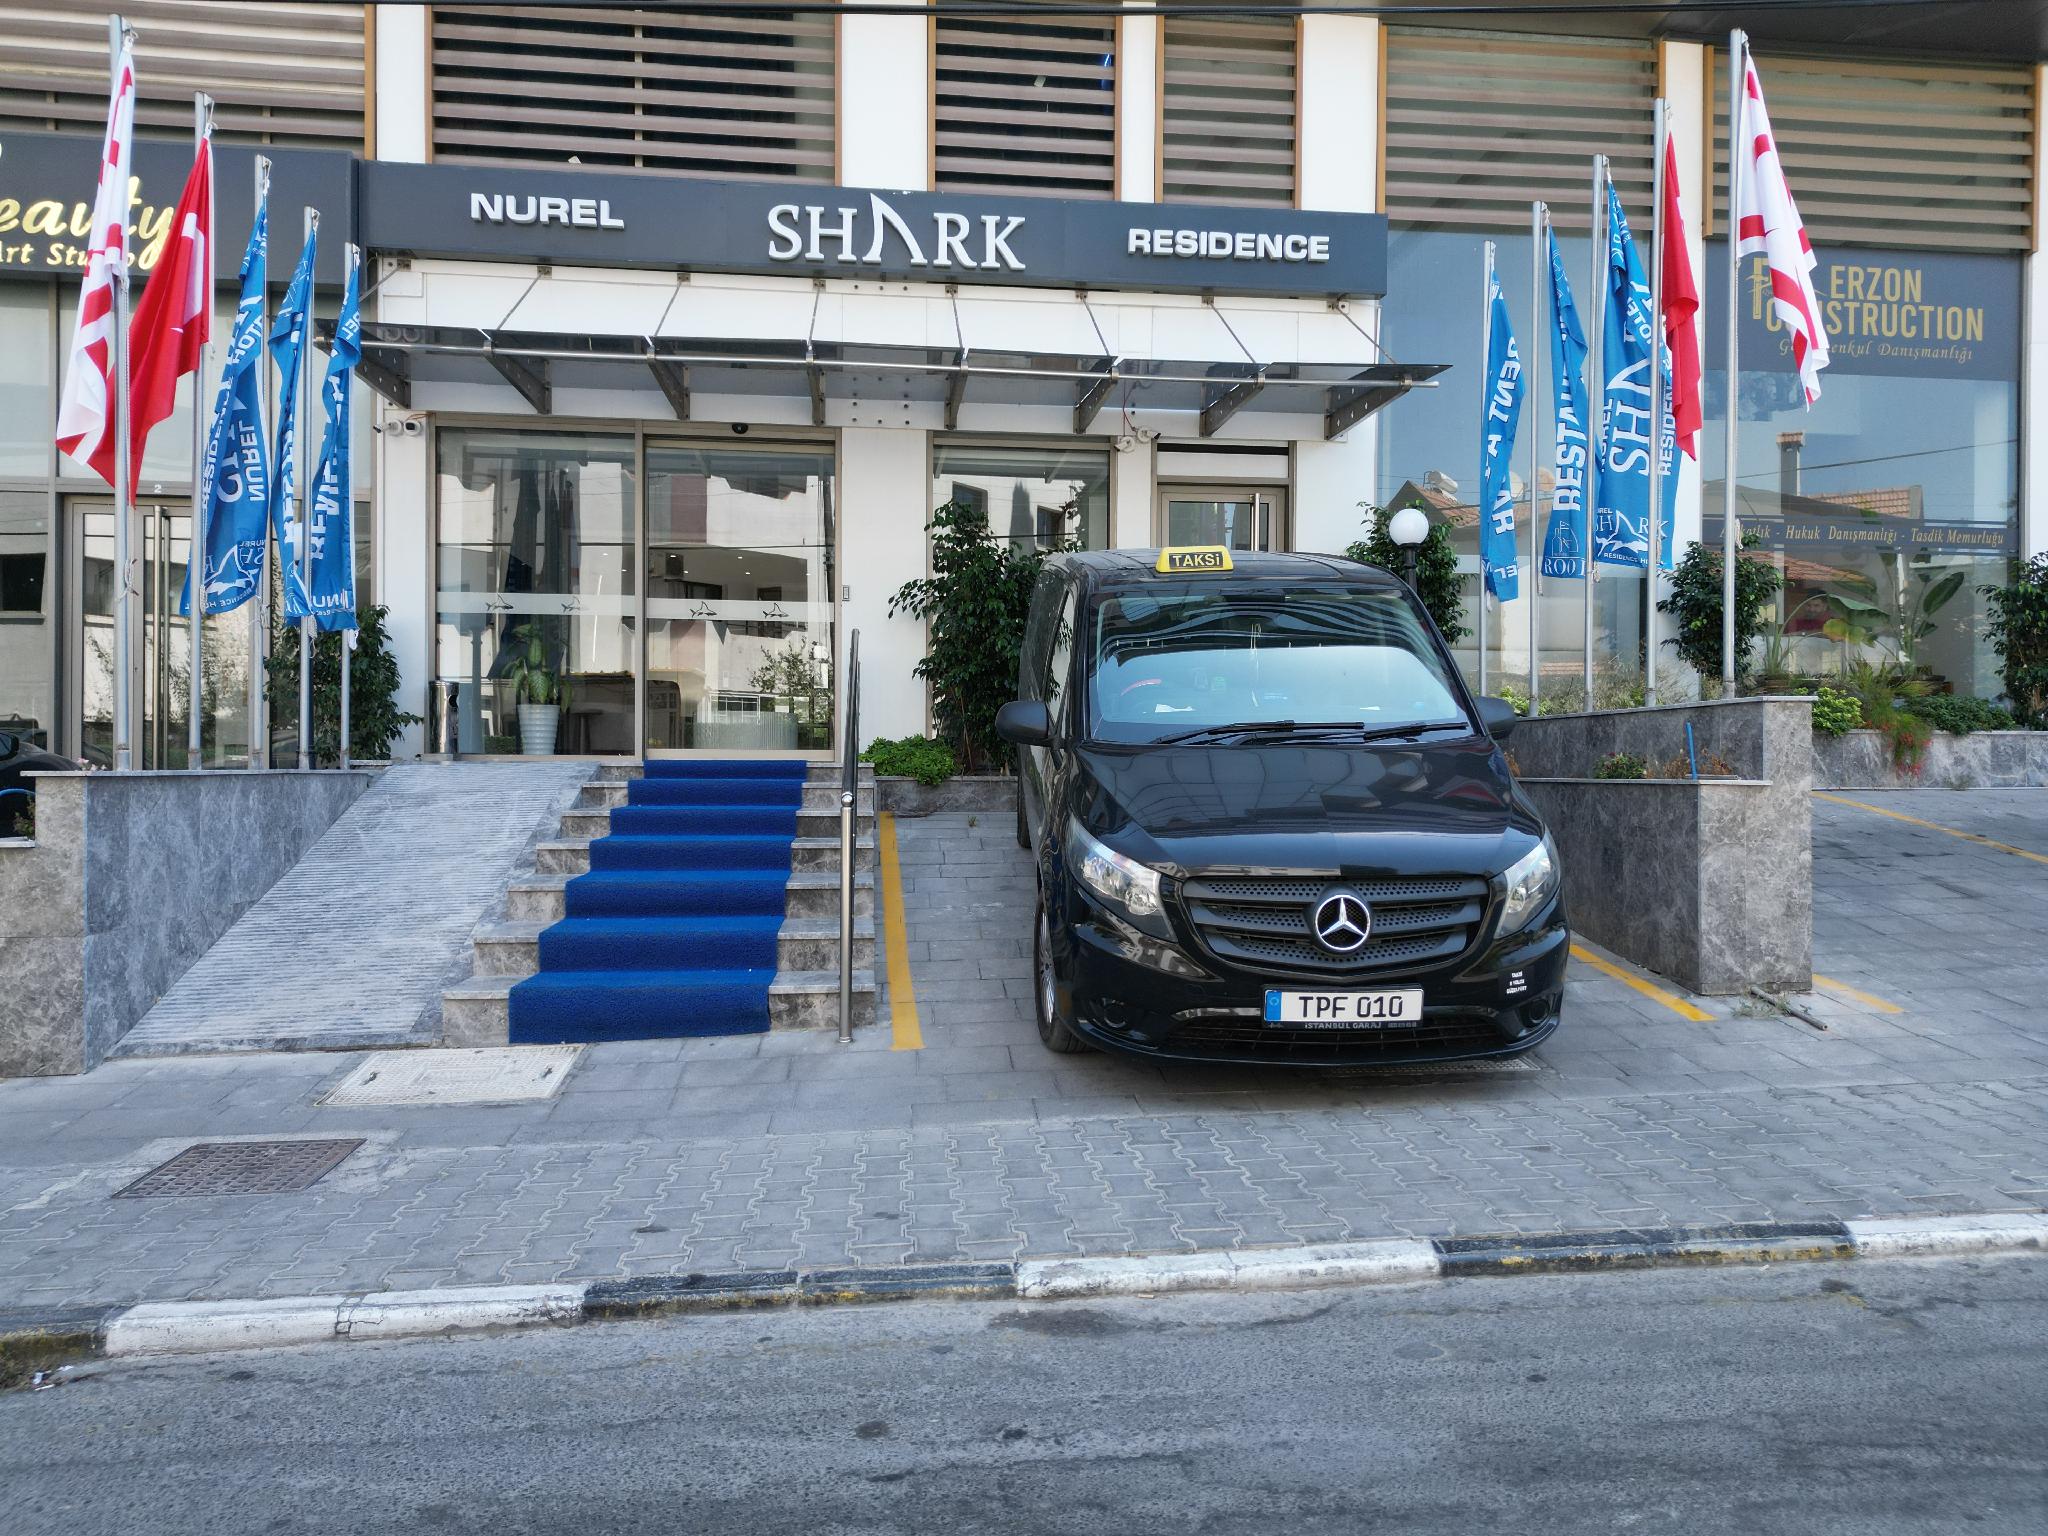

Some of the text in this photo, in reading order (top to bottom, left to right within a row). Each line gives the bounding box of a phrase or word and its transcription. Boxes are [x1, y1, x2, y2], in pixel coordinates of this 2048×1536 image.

[0, 176, 174, 270] eauty
[470, 192, 625, 230] NUREL
[767, 192, 1027, 271] SHARK
[1127, 228, 1330, 263] RESIDENCE
[46, 243, 135, 266] Stuo
[1830, 265, 1922, 303] ERZON
[1766, 298, 1983, 342] CSTRUCTION
[1786, 525, 1821, 539] Hukuk
[1911, 527, 1944, 543] Tasdik
[1298, 995, 1403, 1018] TPF 010
